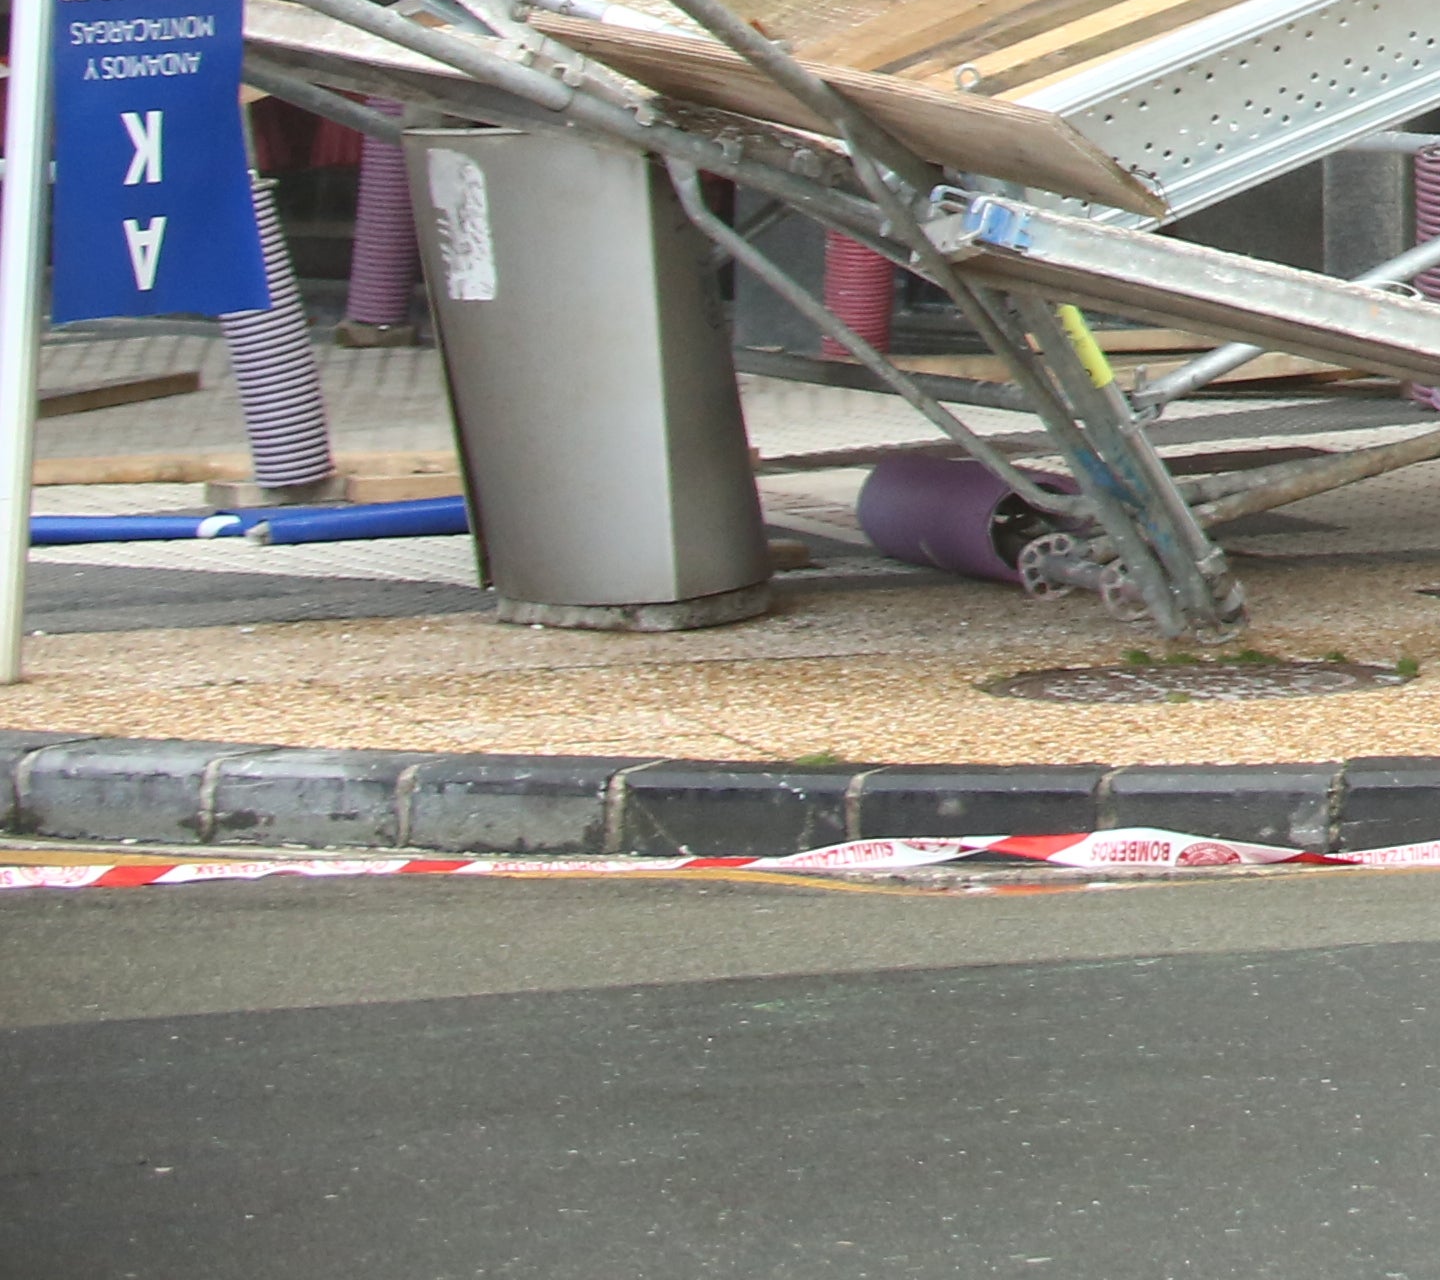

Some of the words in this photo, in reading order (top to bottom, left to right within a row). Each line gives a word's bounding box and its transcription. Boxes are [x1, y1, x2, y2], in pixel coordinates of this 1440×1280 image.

[70, 15, 215, 45] MONTACARGAS
[84, 57, 100, 81] Y
[120, 110, 164, 185] K
[123, 216, 168, 290] A
[1090, 841, 1171, 864] BOMBEROS
